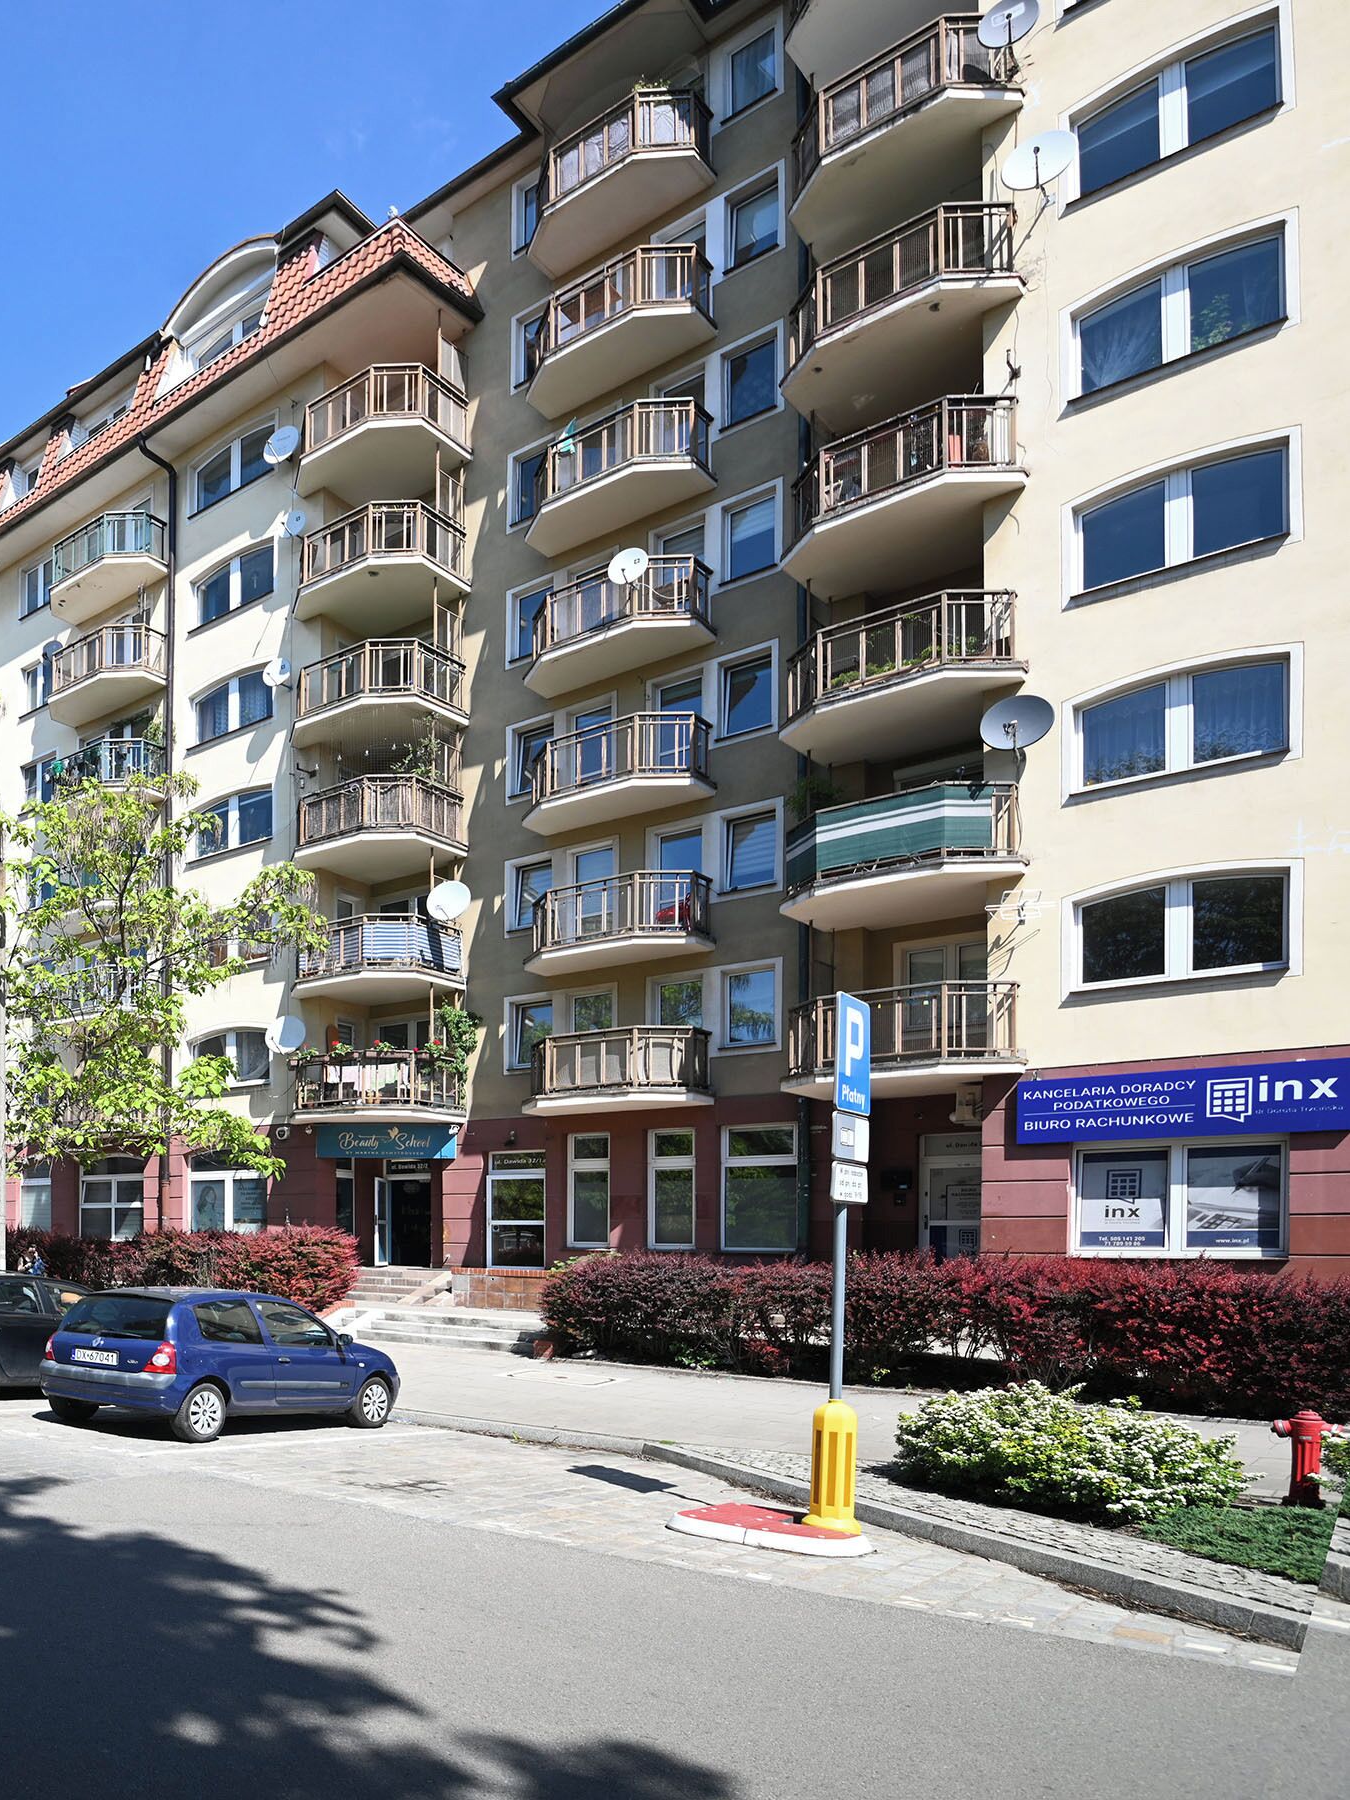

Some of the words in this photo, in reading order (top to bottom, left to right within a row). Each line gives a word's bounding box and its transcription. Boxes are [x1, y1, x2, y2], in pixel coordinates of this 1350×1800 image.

[841, 1083, 866, 1110] Płatny
[1023, 1085, 1116, 1100] KANCELARIA
[1120, 1080, 1196, 1094] DORADCY
[1259, 1075, 1338, 1102] inx
[1053, 1095, 1170, 1111] PODATKOWEGO
[1024, 1119, 1071, 1131] BIURO
[1075, 1112, 1195, 1129] RACHUNKOWE
[338, 1132, 379, 1150] Beauty
[395, 1132, 430, 1150] School
[1104, 1205, 1140, 1218] inx
[76, 1349, 87, 1360] DX
[90, 1351, 114, 1363] 67041
